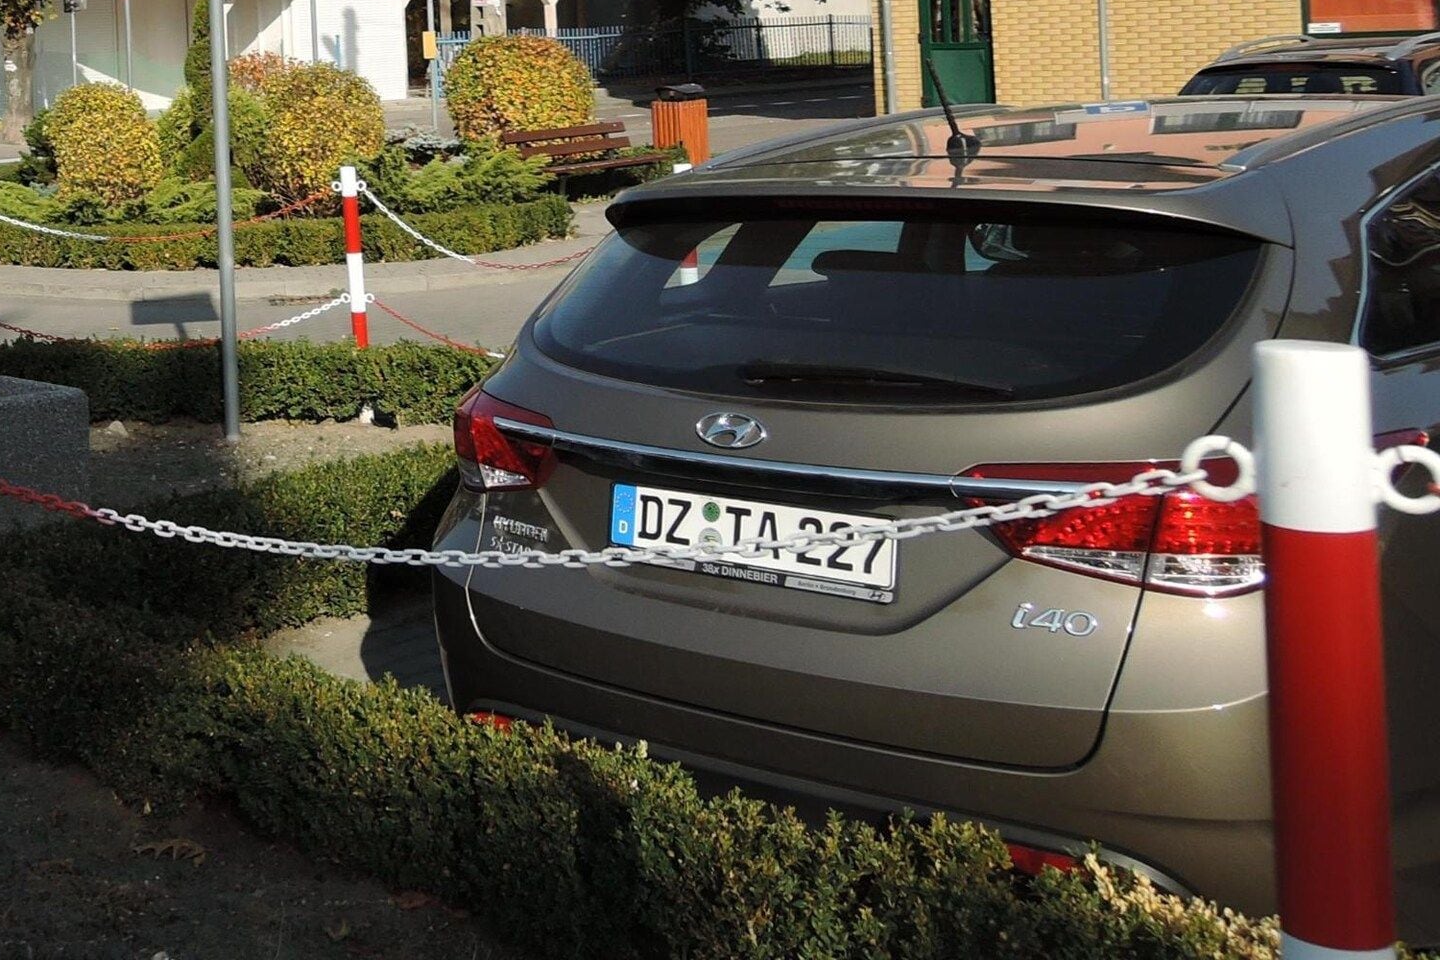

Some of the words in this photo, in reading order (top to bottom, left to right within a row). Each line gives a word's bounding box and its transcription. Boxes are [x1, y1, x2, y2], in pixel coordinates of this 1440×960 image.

[618, 520, 628, 534] D
[638, 494, 692, 545] DZ
[726, 506, 780, 559] TA
[795, 517, 888, 574] 227
[721, 565, 779, 584] DINNEBIER
[1011, 602, 1098, 637] i40
